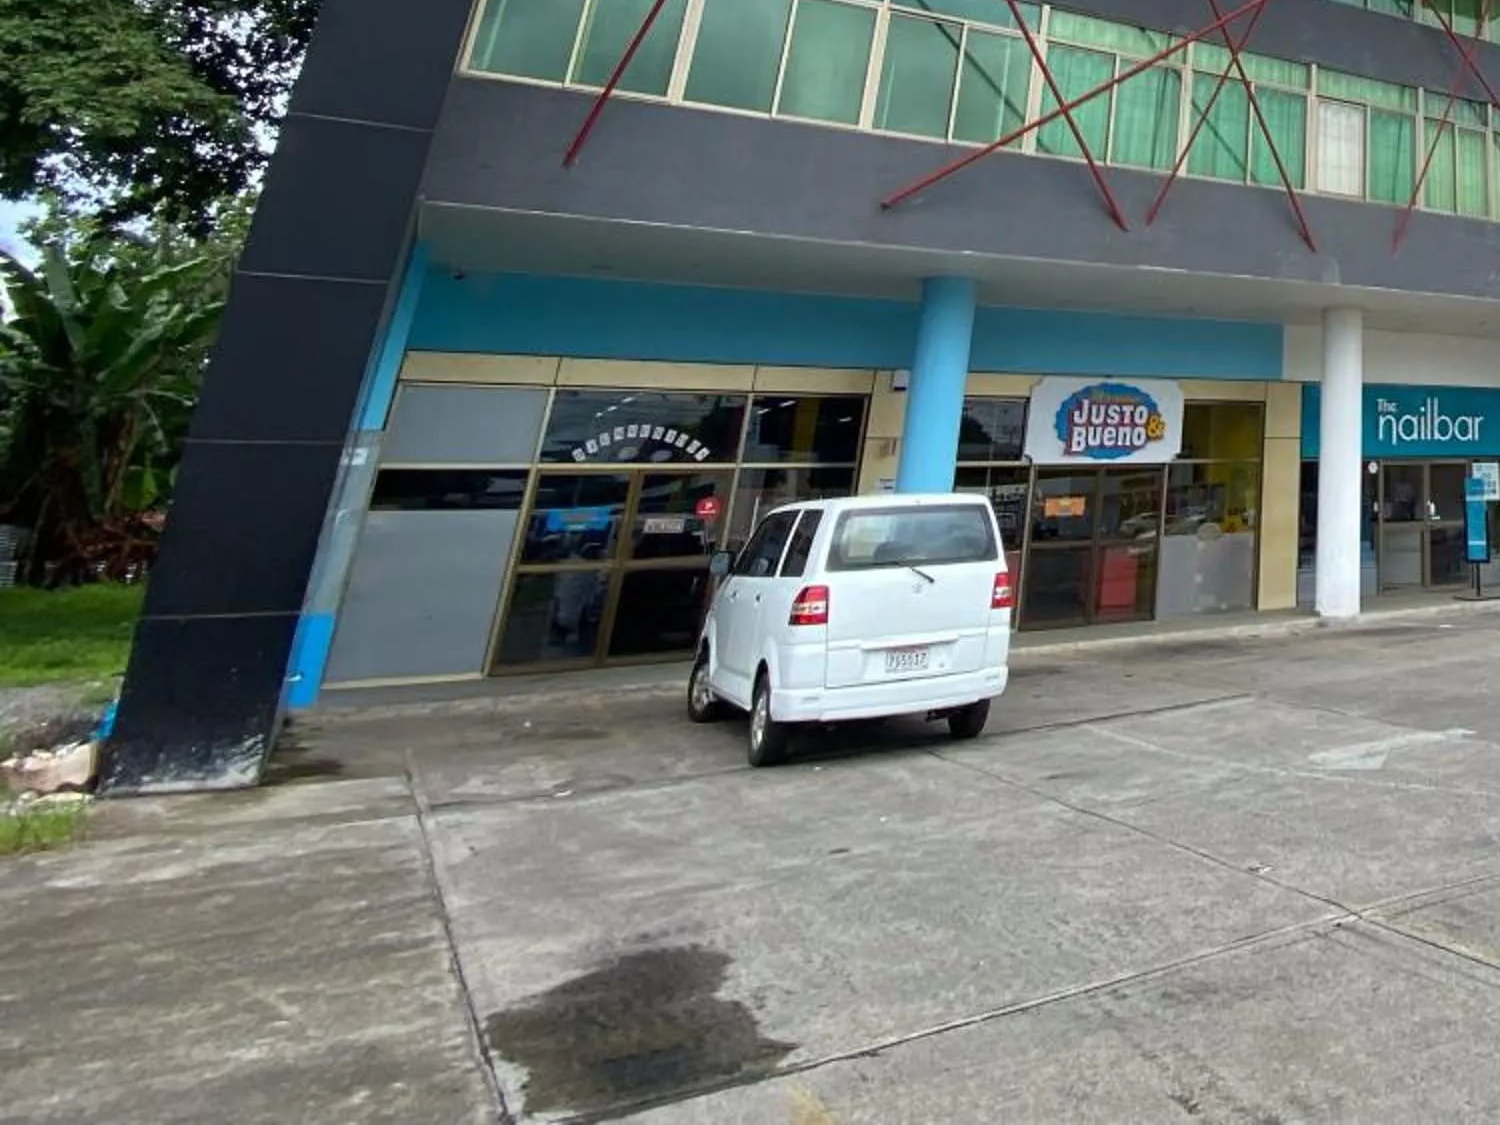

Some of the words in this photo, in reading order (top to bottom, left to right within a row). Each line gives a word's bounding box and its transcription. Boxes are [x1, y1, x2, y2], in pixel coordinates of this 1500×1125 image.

[1073, 399, 1149, 425] JUSTO
[1376, 398, 1398, 413] The
[1378, 396, 1484, 446] nailbar
